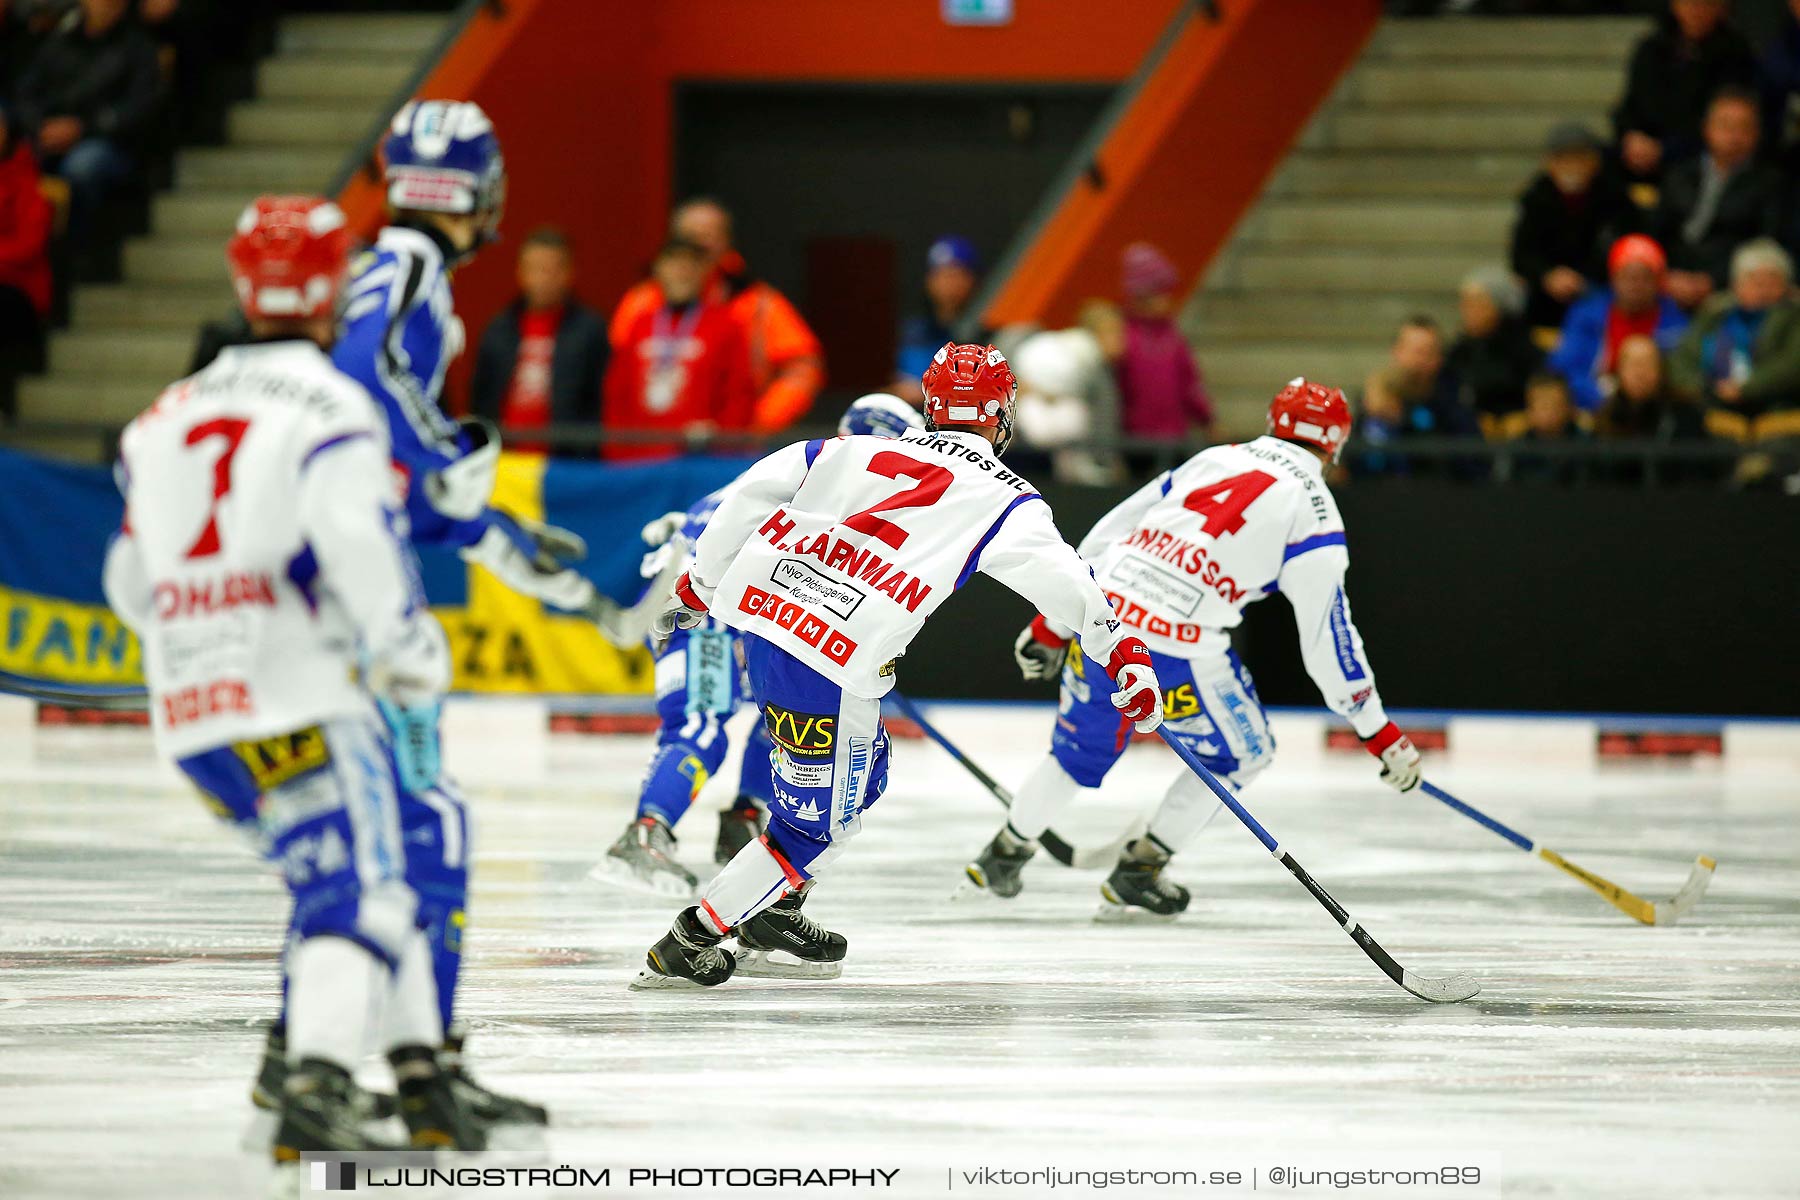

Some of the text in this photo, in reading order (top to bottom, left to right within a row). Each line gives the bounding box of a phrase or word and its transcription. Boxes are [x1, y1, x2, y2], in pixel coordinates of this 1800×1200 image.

[931, 396, 943, 411] 2
[184, 417, 252, 560] 7
[899, 436, 1026, 491] HURTIGS BIL
[1243, 445, 1316, 491] HURTIGS
[1310, 495, 1328, 522] BIL
[866, 450, 955, 551] 2
[1183, 469, 1279, 540] 4
[781, 564, 804, 580] Nya
[743, 589, 853, 663] CRAMO
[767, 705, 834, 748] YVS
[785, 759, 832, 773] MARBERGS
